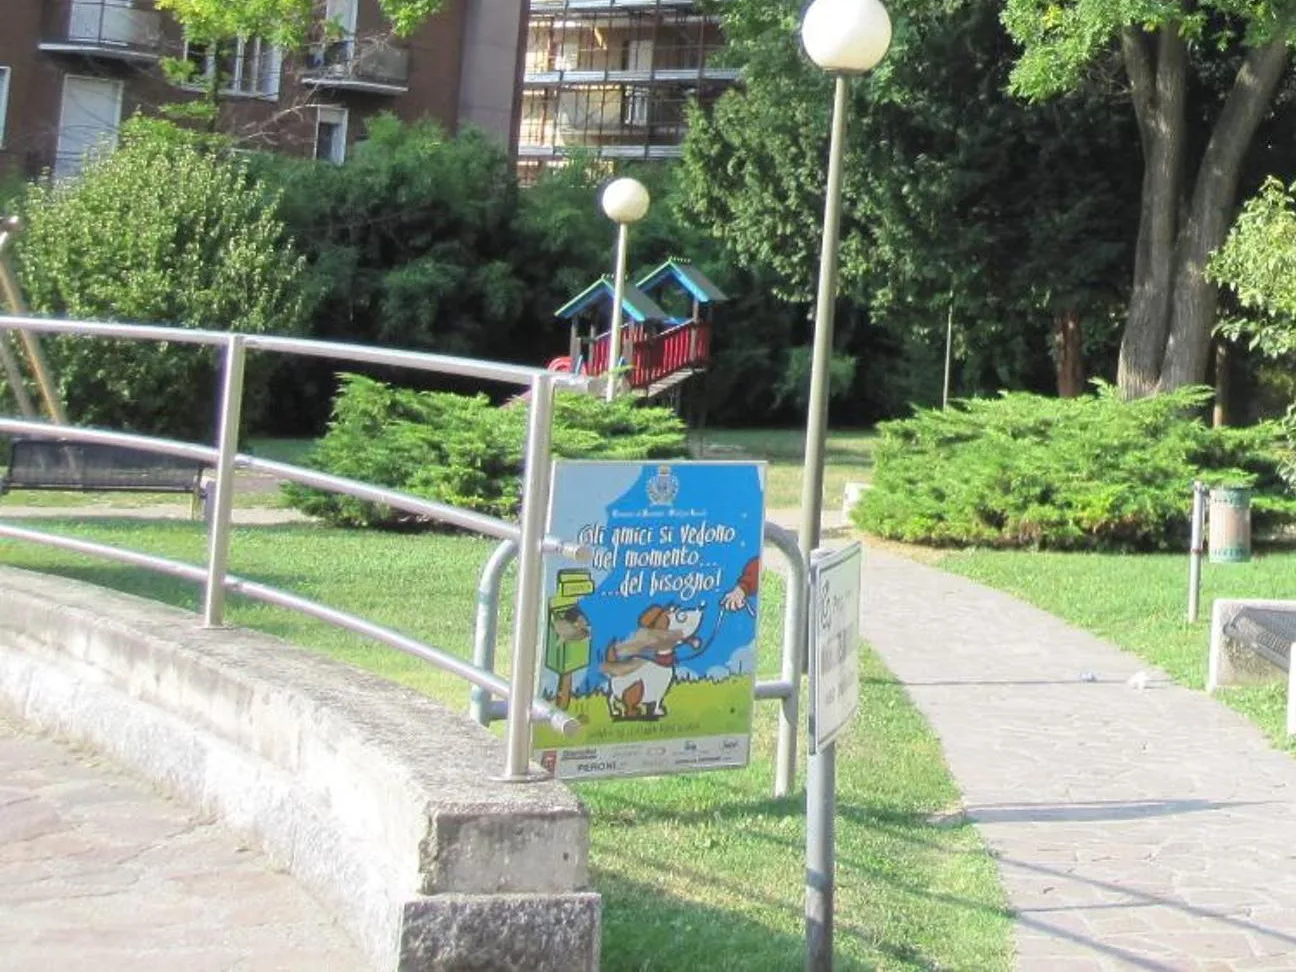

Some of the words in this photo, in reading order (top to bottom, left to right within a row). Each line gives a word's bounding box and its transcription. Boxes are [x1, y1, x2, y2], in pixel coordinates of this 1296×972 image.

[612, 526, 653, 547] amici
[659, 526, 672, 544] si
[593, 545, 618, 569] nel
[649, 569, 722, 601] bisogno!
